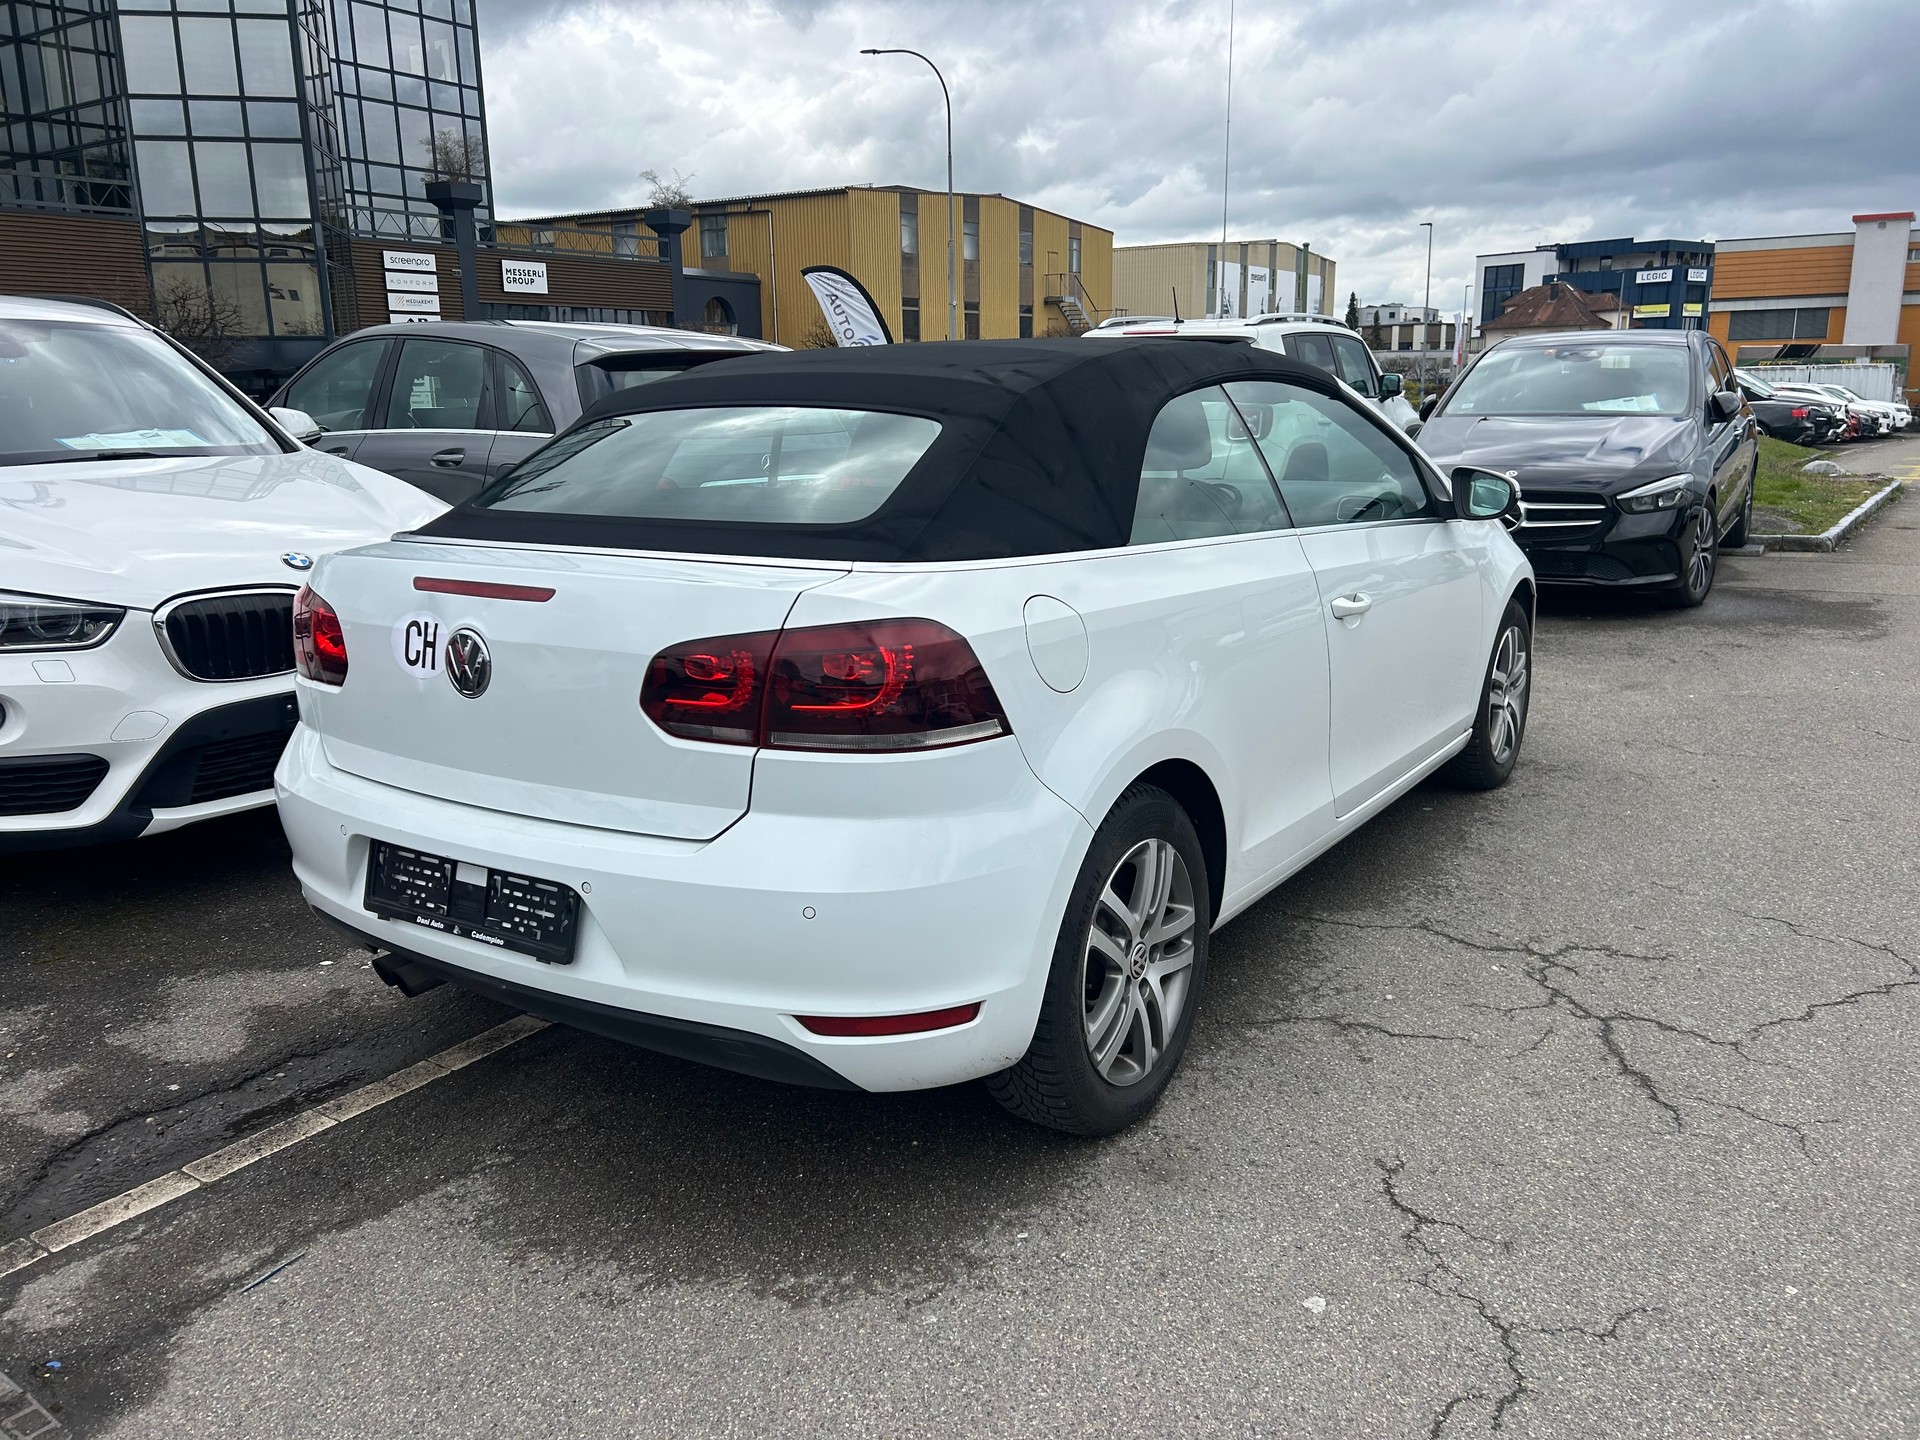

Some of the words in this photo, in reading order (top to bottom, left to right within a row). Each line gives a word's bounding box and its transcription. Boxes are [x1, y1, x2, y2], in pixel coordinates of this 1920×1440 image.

[390, 256, 430, 266] screenpro
[505, 268, 544, 278] MESSERLI
[1641, 272, 1667, 281] LEGIC
[1690, 271, 1704, 279] LEGIC
[390, 279, 434, 287] KONFORM
[405, 620, 438, 670] CH
[416, 915, 430, 926] Dani
[430, 919, 444, 929] Auto
[471, 930, 504, 946] Cadempino
